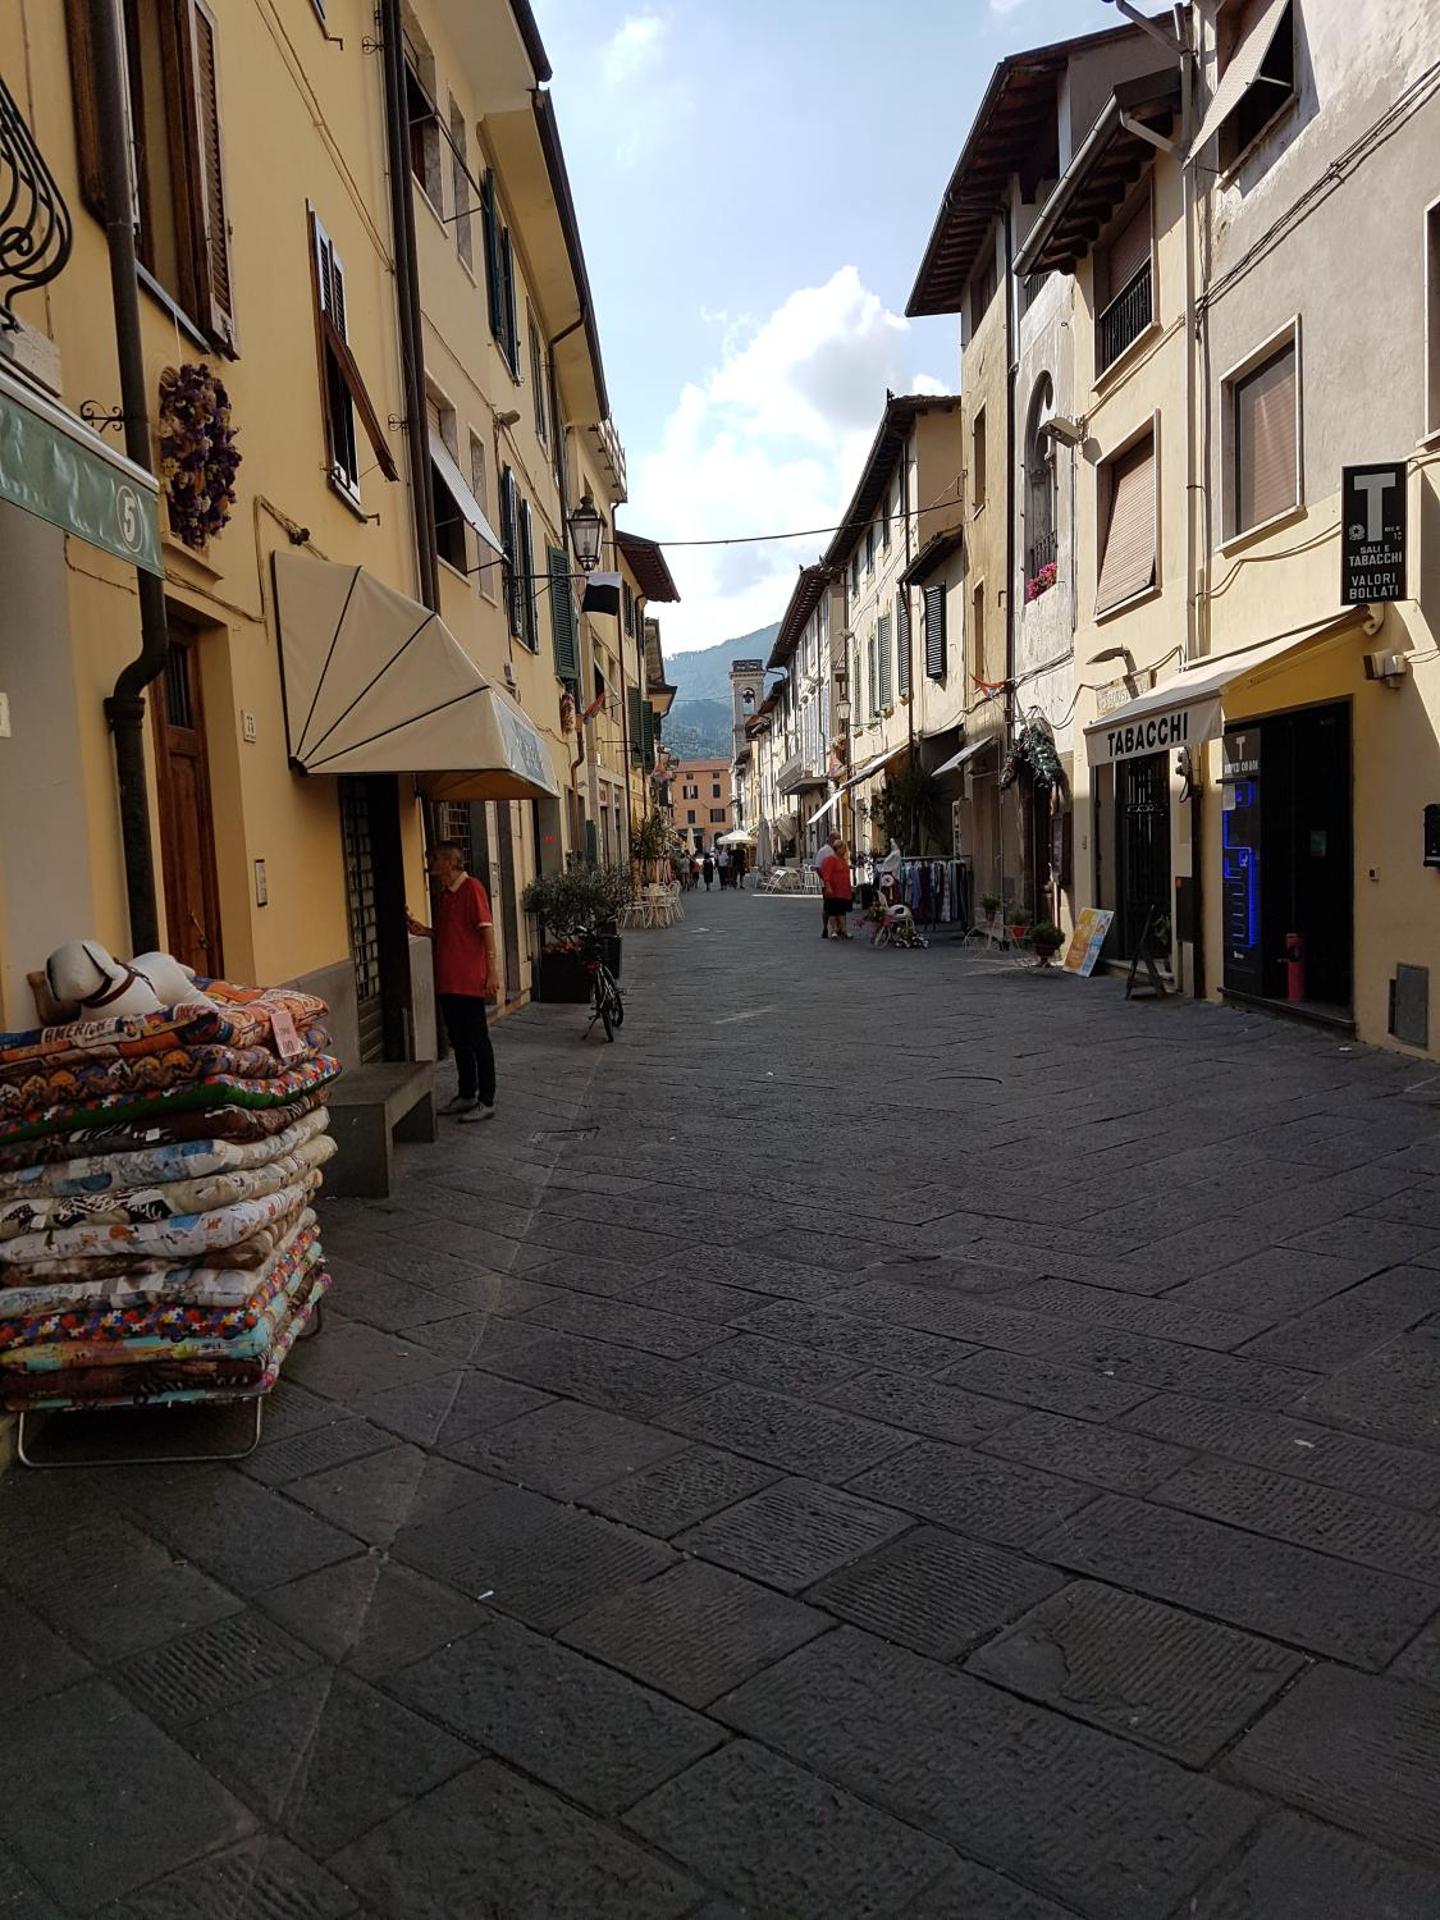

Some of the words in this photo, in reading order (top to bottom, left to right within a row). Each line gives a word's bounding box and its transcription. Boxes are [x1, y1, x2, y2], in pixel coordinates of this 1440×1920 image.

[1354, 472, 1396, 542] T
[123, 496, 135, 542] 5
[1360, 545, 1381, 554] SALI
[1384, 544, 1390, 553] E
[1349, 552, 1402, 567] TABACCHI
[1351, 572, 1396, 587] VALORI
[1350, 585, 1399, 600] BOLLATI
[1107, 712, 1188, 757] TABACCHI
